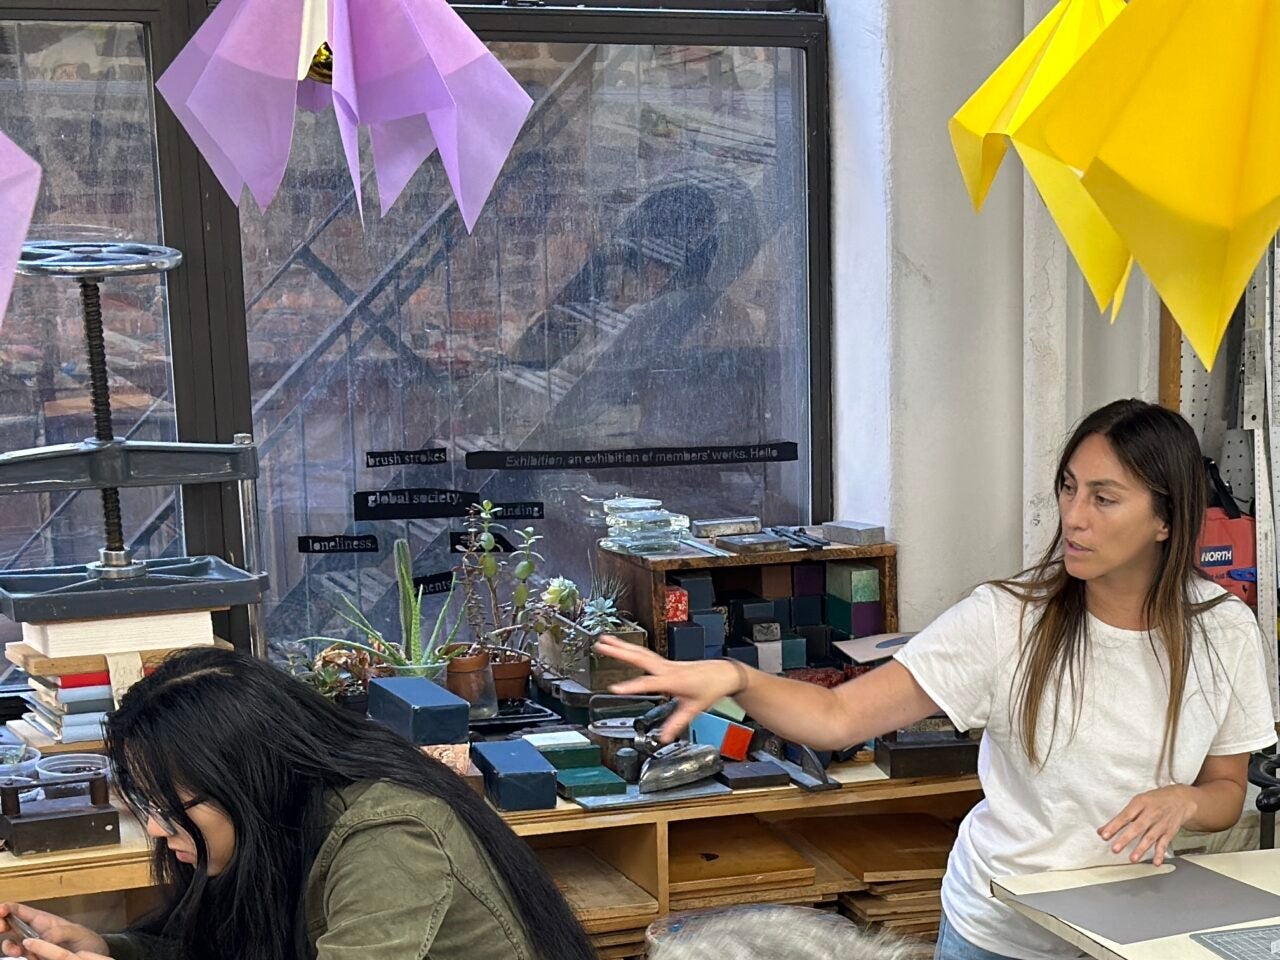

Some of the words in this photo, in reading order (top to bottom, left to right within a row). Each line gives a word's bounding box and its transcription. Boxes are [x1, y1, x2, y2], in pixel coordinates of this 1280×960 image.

[367, 453, 401, 466] brush
[404, 451, 446, 464] strokes
[568, 455, 582, 465] an
[584, 452, 640, 464] exhibition
[641, 451, 653, 462] of
[655, 449, 711, 462] members'
[750, 448, 778, 459] Hello
[367, 492, 410, 507] global
[413, 491, 463, 505] society.
[308, 537, 376, 551] loneliness.
[1200, 550, 1233, 562] NORTH
